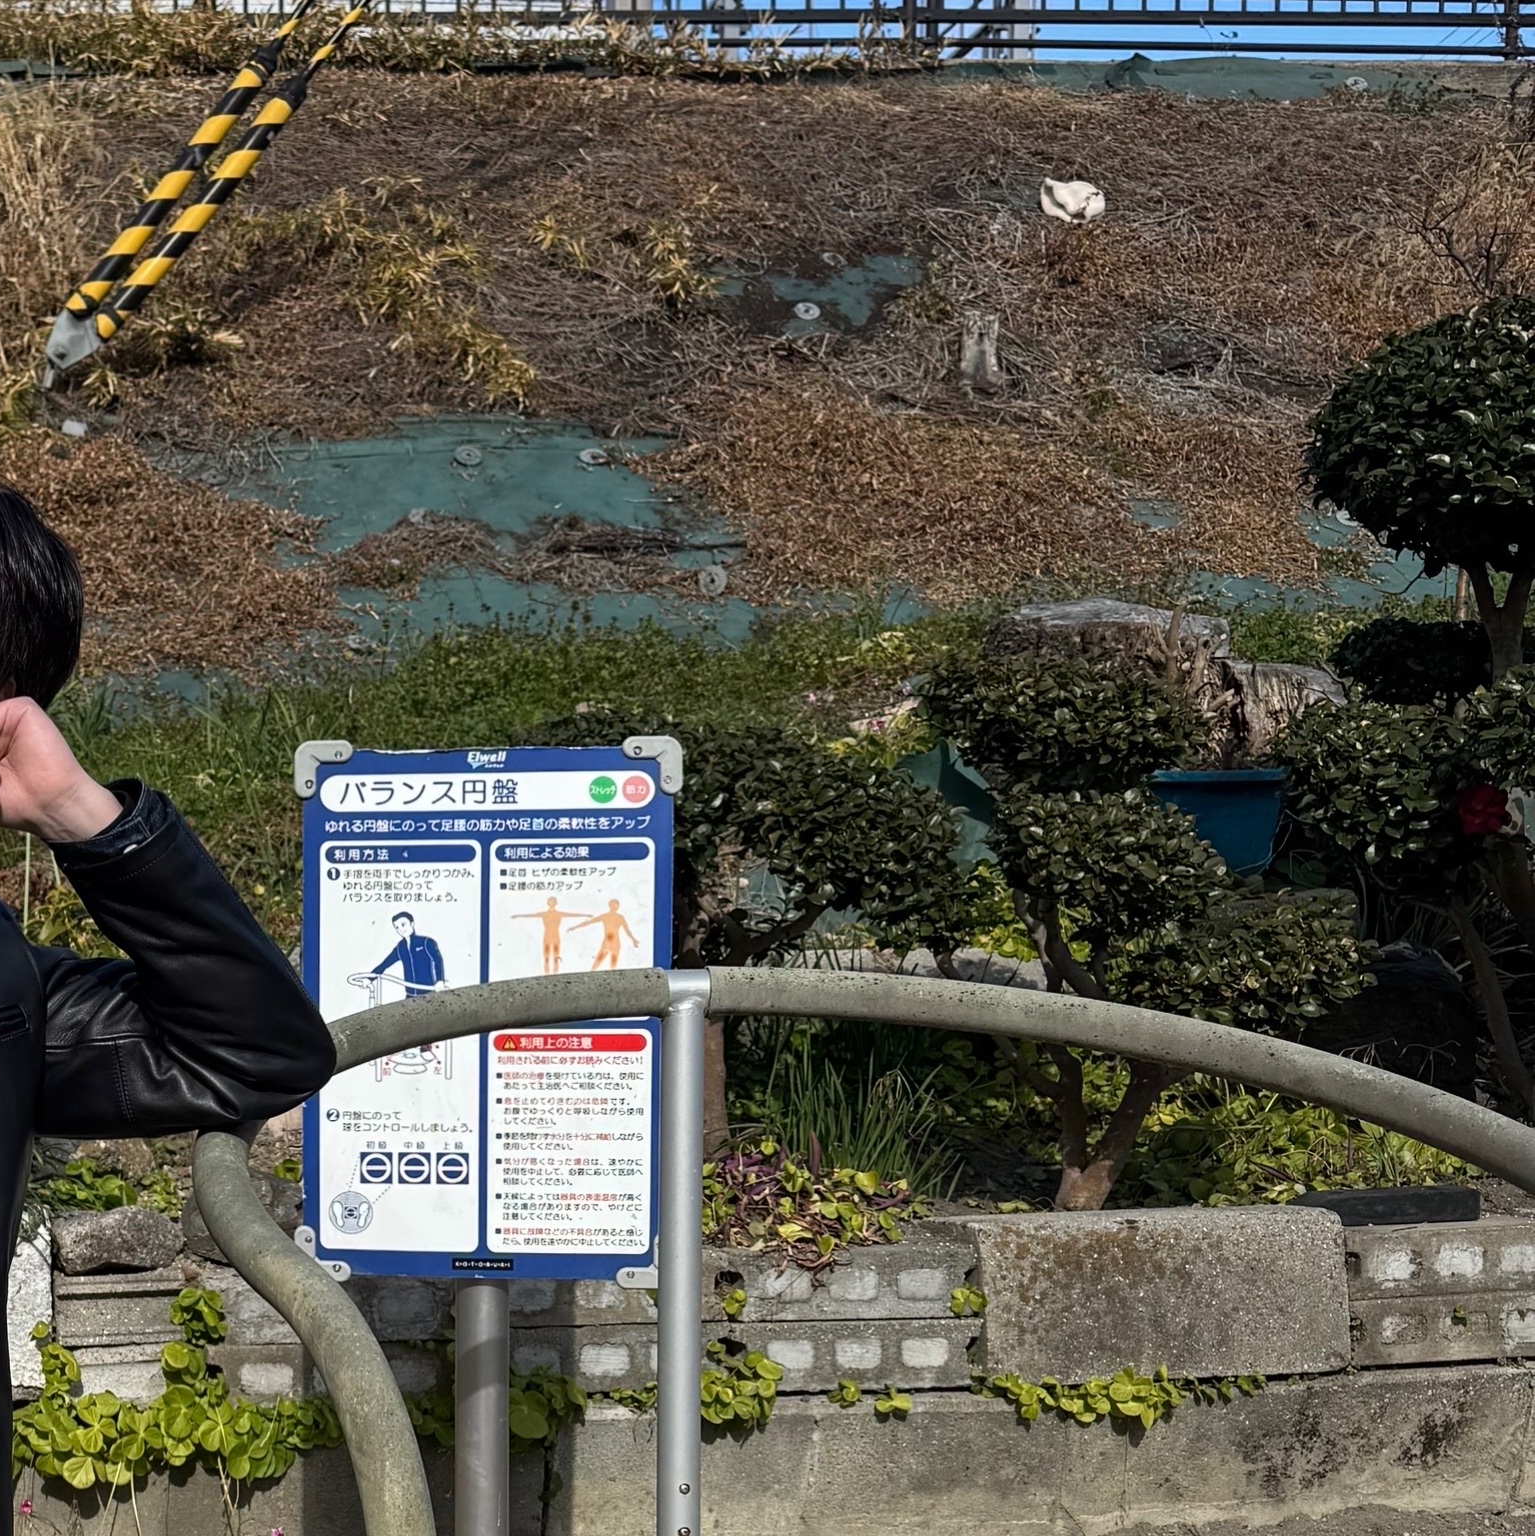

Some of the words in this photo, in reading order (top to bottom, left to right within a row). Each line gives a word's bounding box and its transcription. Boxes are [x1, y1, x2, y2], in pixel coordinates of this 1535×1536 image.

[467, 751, 507, 762] Elwell
[340, 779, 518, 805] バランス円盤
[590, 785, 616, 794] ストレッチ
[626, 785, 646, 794] 筋力
[325, 816, 651, 833] ゆれる円盤にのって足腰の筋力や足首の柔軟性をアップ
[334, 848, 389, 861] 利用方法
[503, 846, 590, 859] 利用による効果
[343, 868, 475, 879] 手摺を両手でしっかりつかみ、
[343, 881, 433, 891] ゆれる円盤にのって
[509, 881, 583, 891] 足腰の筋力アップ
[343, 892, 458, 903] バランスを取りましょう。
[519, 1037, 593, 1050] 利用上の注意
[503, 1082, 633, 1091] あたって主治医へご相談ください。
[342, 1111, 402, 1120] 円盤にのって
[503, 1107, 644, 1116] お腹でゆっくりと呼吸しながら使用
[504, 1117, 557, 1126] してください。
[342, 1123, 473, 1133] 球をコントロールしましょう。
[366, 1141, 387, 1150] 初級
[404, 1141, 425, 1150] 中級
[443, 1141, 463, 1150] 上級
[503, 1142, 574, 1151] 使用してください。
[504, 1158, 643, 1167] 気分が悪くなった場合は、速やかに
[503, 1177, 573, 1186] 相談してください。
[503, 1193, 642, 1202] 天候によっては器具の表面温度が高く
[502, 1203, 643, 1211] なる場合がありますので、やけどに
[502, 1213, 573, 1221] 注意してください。
[502, 1237, 646, 1247] たら、使用を速やかに中止してください。
